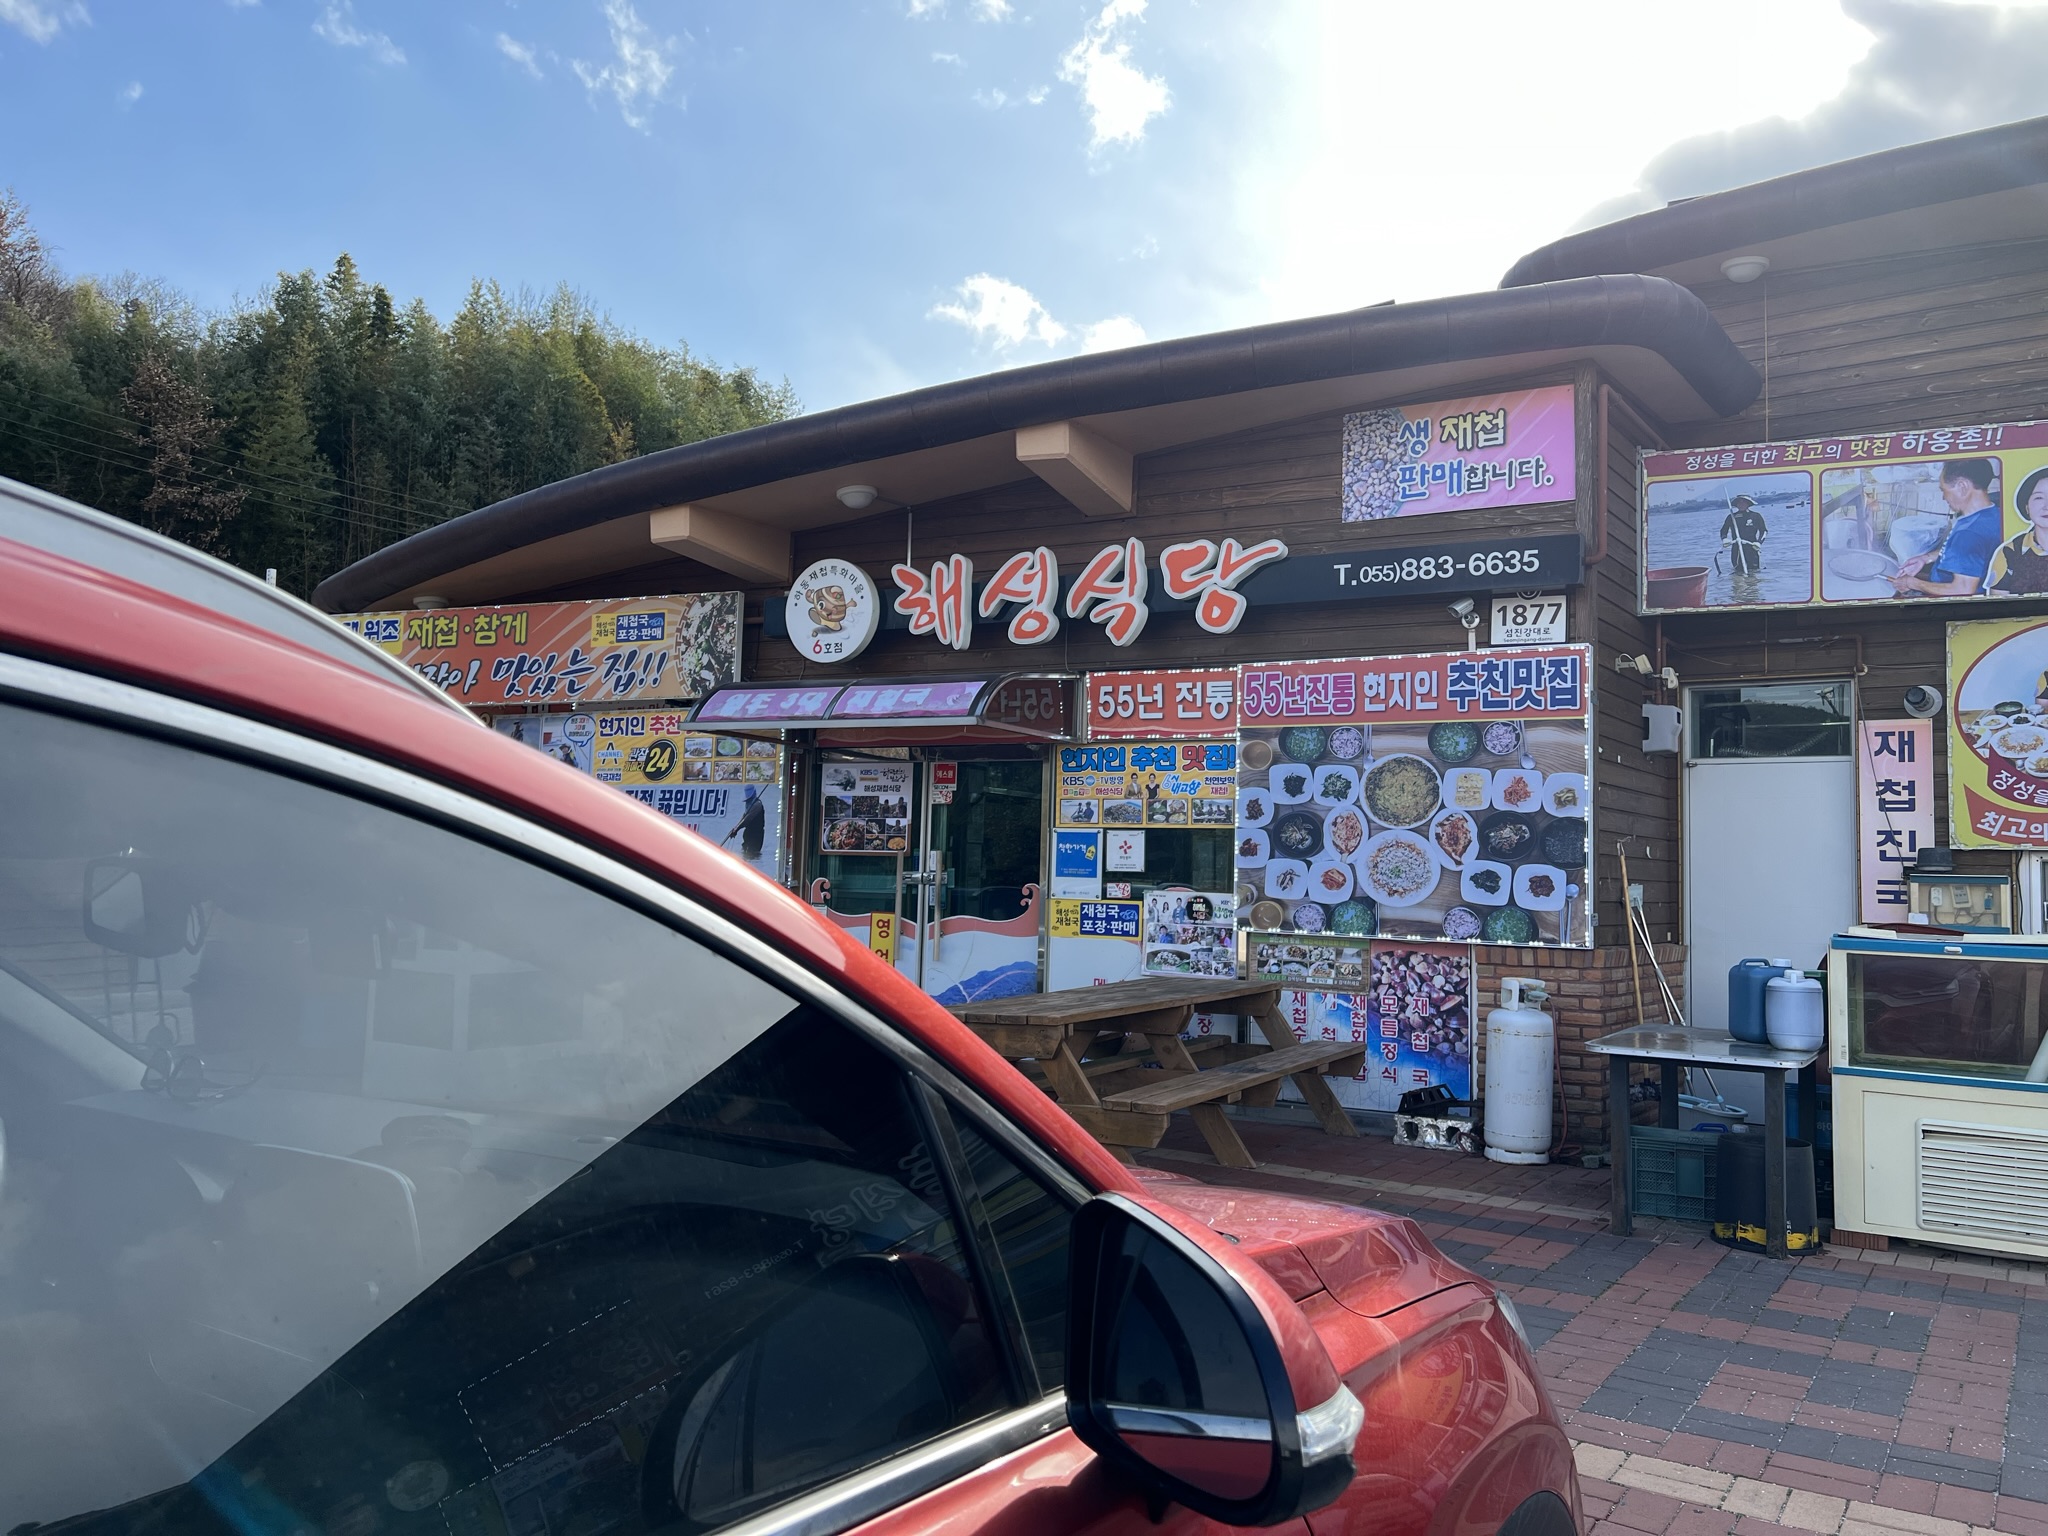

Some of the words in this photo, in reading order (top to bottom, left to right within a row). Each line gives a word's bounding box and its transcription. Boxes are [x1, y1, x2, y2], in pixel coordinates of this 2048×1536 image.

[1400, 418, 1431, 457] 생
[1440, 408, 1507, 451] 재첩
[1685, 452, 1736, 471] 정성을
[1743, 449, 1778, 466] 더한
[1783, 444, 1842, 463] 최고의
[1850, 437, 1891, 458] 맛집
[1902, 426, 2003, 454] 하옹촌!!
[1398, 455, 1554, 501] 판매합니다.
[1333, 549, 1540, 586] T.055)883-6635
[891, 537, 1288, 650] 해성식당
[617, 614, 649, 628] 재첩국
[1496, 603, 1562, 627] 1877
[407, 611, 528, 650] 재첩·참게
[596, 628, 615, 638] 재첩국
[617, 627, 662, 641] 포장·판매
[1505, 627, 1551, 638] 섬진강대로
[813, 640, 843, 654] 6호점
[491, 647, 597, 698] 맛있는
[602, 648, 669, 695] 집!!
[1243, 671, 1356, 717] 55년전통
[1363, 670, 1438, 712] 현지인
[1447, 655, 1580, 712] 추천맛집
[1098, 682, 1164, 720] 55년
[1175, 681, 1233, 720] 전통
[599, 716, 645, 737] 현지인
[649, 714, 682, 736] 추천
[646, 747, 671, 773] 24
[1060, 745, 1126, 773] 현지인
[1130, 745, 1177, 772] 추천
[1182, 744, 1236, 772] 맛집!
[1062, 776, 1084, 786] KBS
[1095, 787, 1123, 796] 해성식당
[1171, 780, 1202, 795] 내고향
[1992, 769, 2048, 806] 정성을
[658, 788, 729, 817] 끓입니다!
[1874, 730, 1918, 905] 재첩진국
[1976, 811, 2048, 842] 최고의
[1055, 917, 1079, 927] 재첩국
[1056, 908, 1070, 917] 해성
[1081, 903, 1120, 919] 재첩국
[1081, 920, 1136, 936] 포장·판매
[1259, 974, 1287, 982] NAVER
[1381, 996, 1398, 1084] 모듬정식
[1412, 998, 1429, 1086] 재첩국
